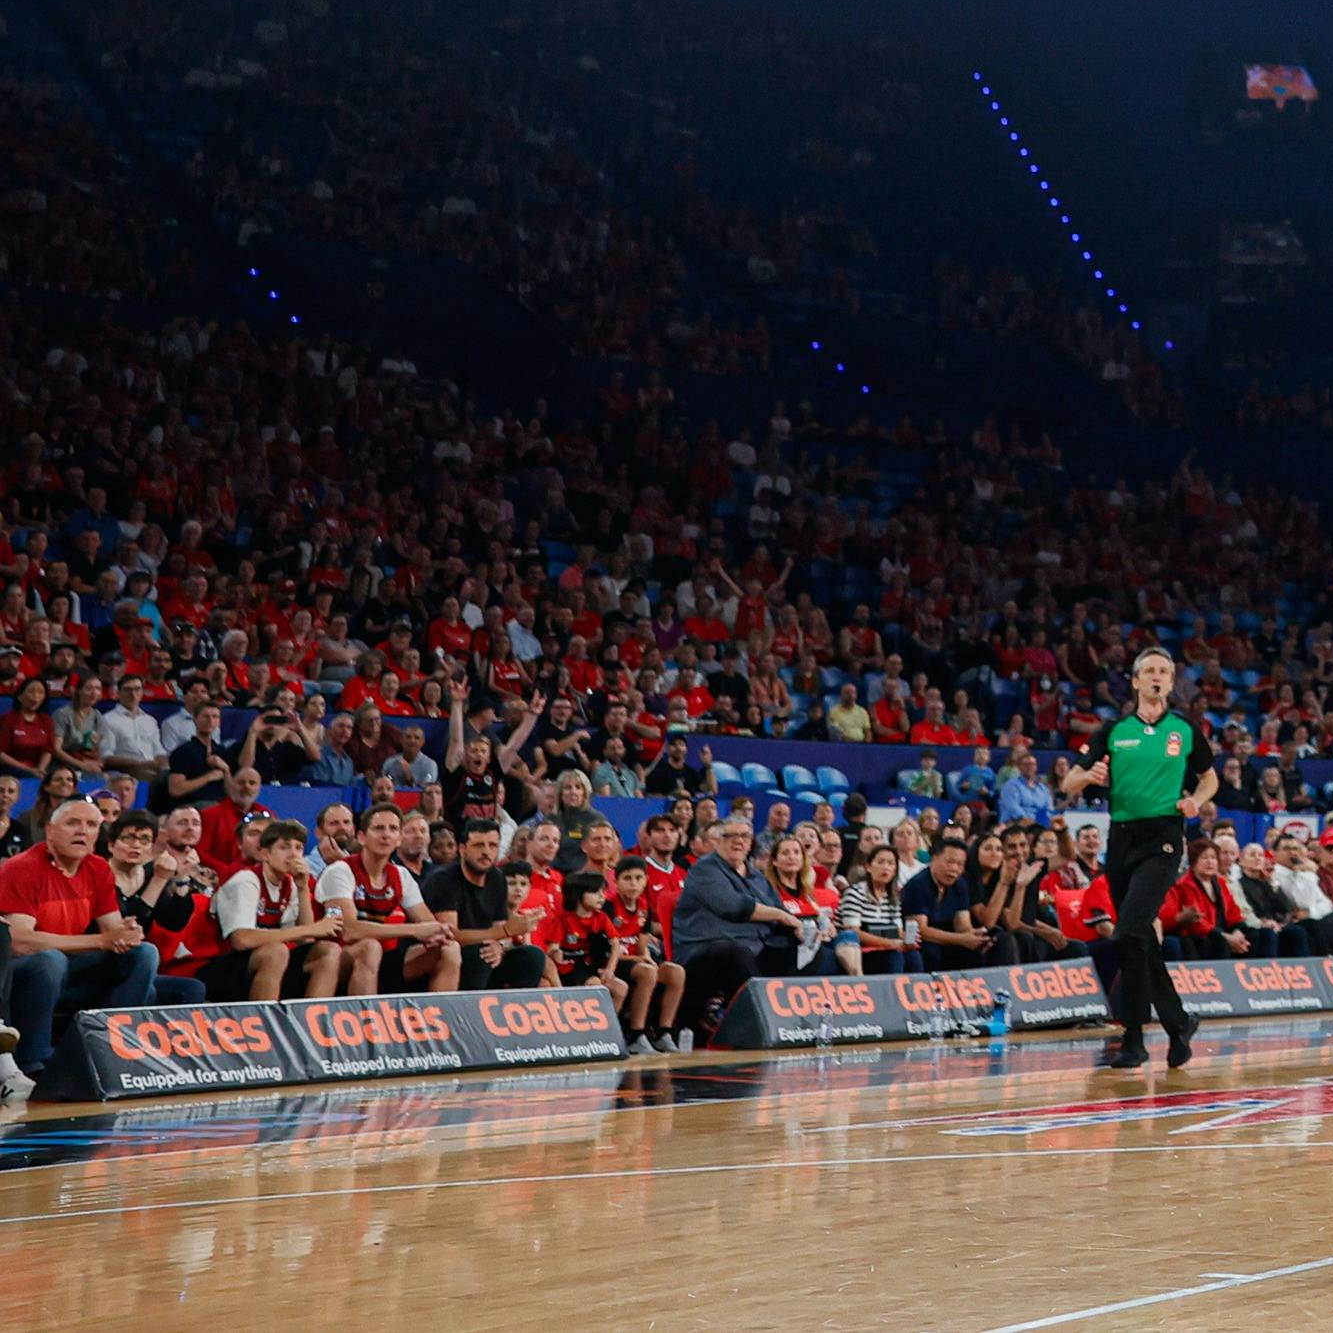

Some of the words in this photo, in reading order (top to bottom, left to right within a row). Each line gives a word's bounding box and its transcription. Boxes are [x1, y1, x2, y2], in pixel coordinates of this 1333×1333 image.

[895, 974, 994, 1012] Coates
[1009, 962, 1100, 1002] Coates
[1170, 962, 1224, 994] ates
[1234, 959, 1314, 991] Coates
[478, 994, 609, 1038] Coates
[765, 977, 876, 1017] Coates
[107, 1008, 273, 1061] Coates
[304, 1000, 451, 1048] Coates
[321, 1057, 385, 1075] Equipped
[385, 1057, 405, 1071] for
[406, 1052, 462, 1071] anything
[494, 1045, 551, 1063] Equipped
[551, 1044, 570, 1059] for
[571, 1041, 619, 1059] anything
[120, 1068, 196, 1091] Equipped
[196, 1067, 219, 1083] for
[220, 1064, 283, 1087] anything
